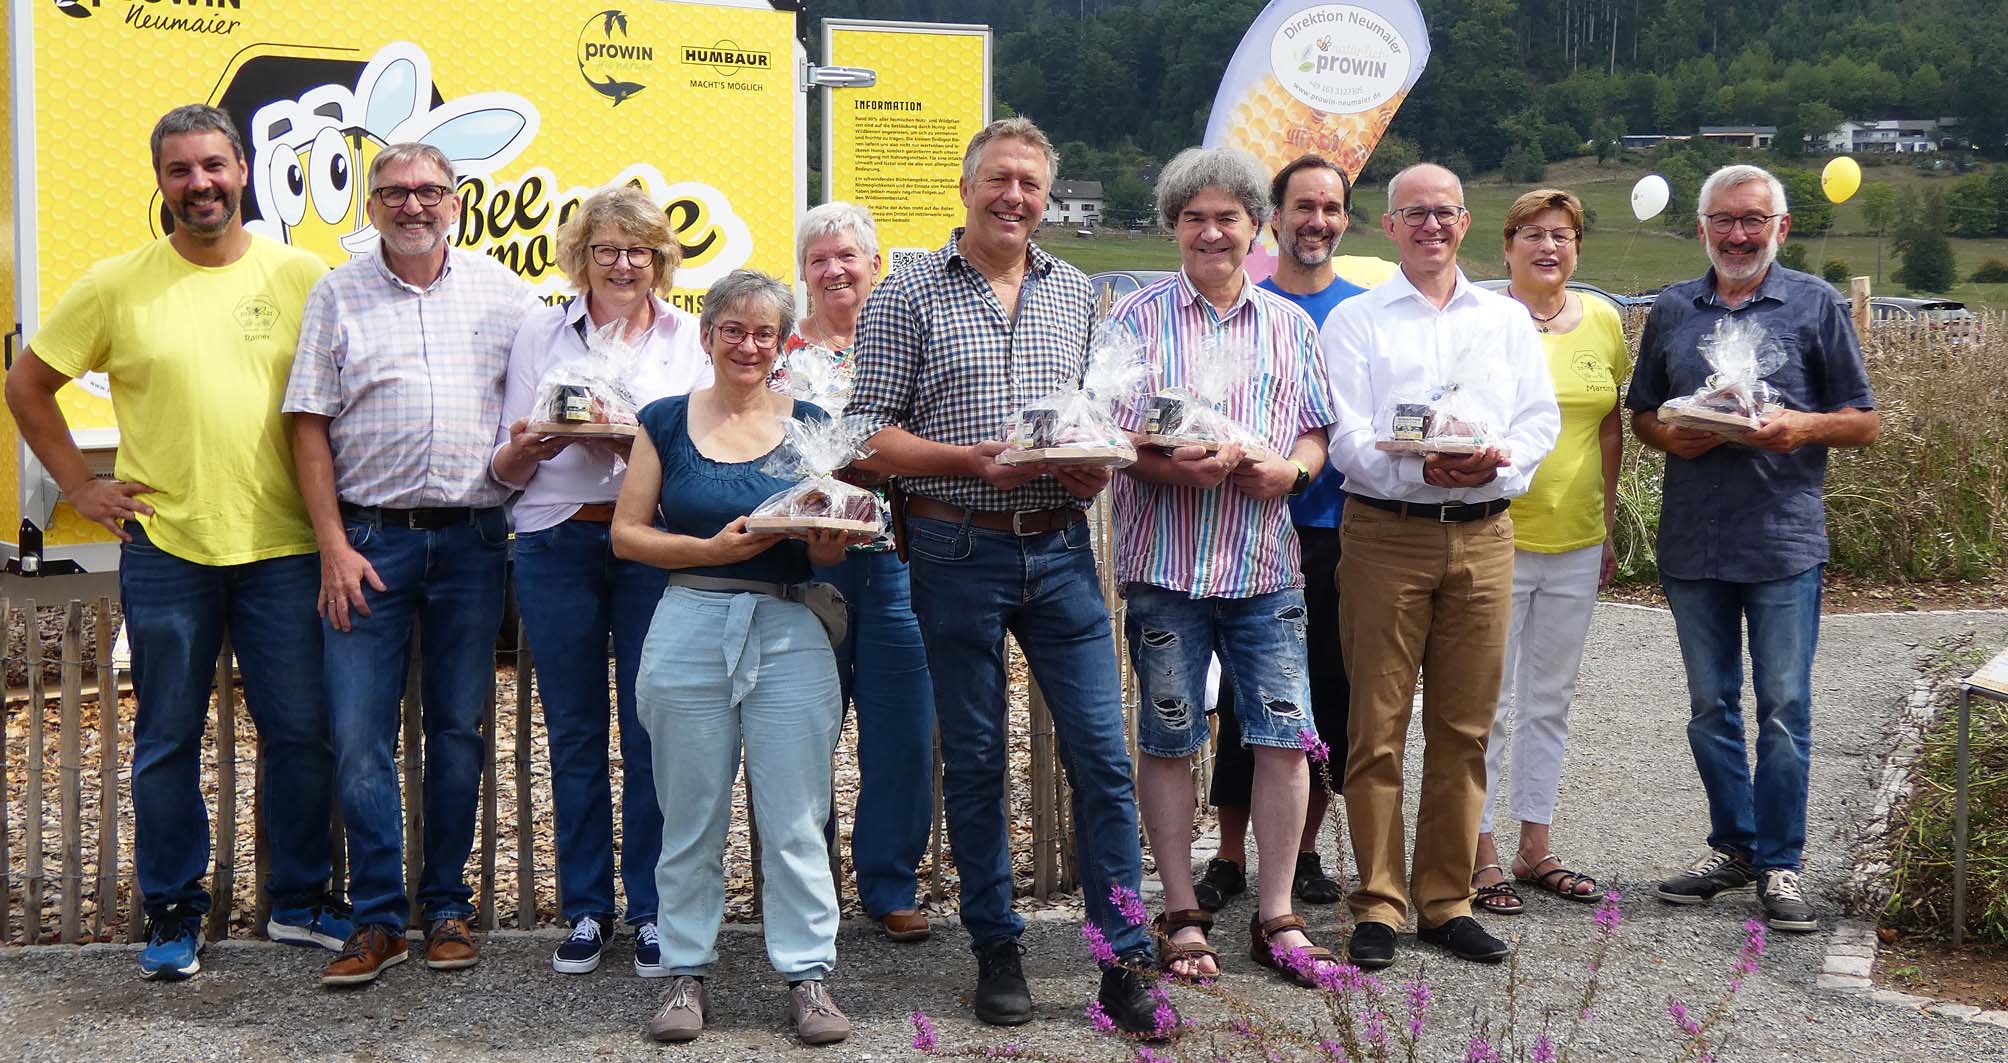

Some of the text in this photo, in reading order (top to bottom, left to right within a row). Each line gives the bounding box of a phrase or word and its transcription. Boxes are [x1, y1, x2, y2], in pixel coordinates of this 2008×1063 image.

[125, 4, 240, 35] Neumaier
[1284, 11, 1401, 54] Direktion Neumaier
[685, 49, 768, 67] HUMBAUR
[690, 80, 763, 92] MACHT'S MÖGLICH
[855, 100, 922, 111] INFORMATION
[453, 176, 550, 247] Bee
